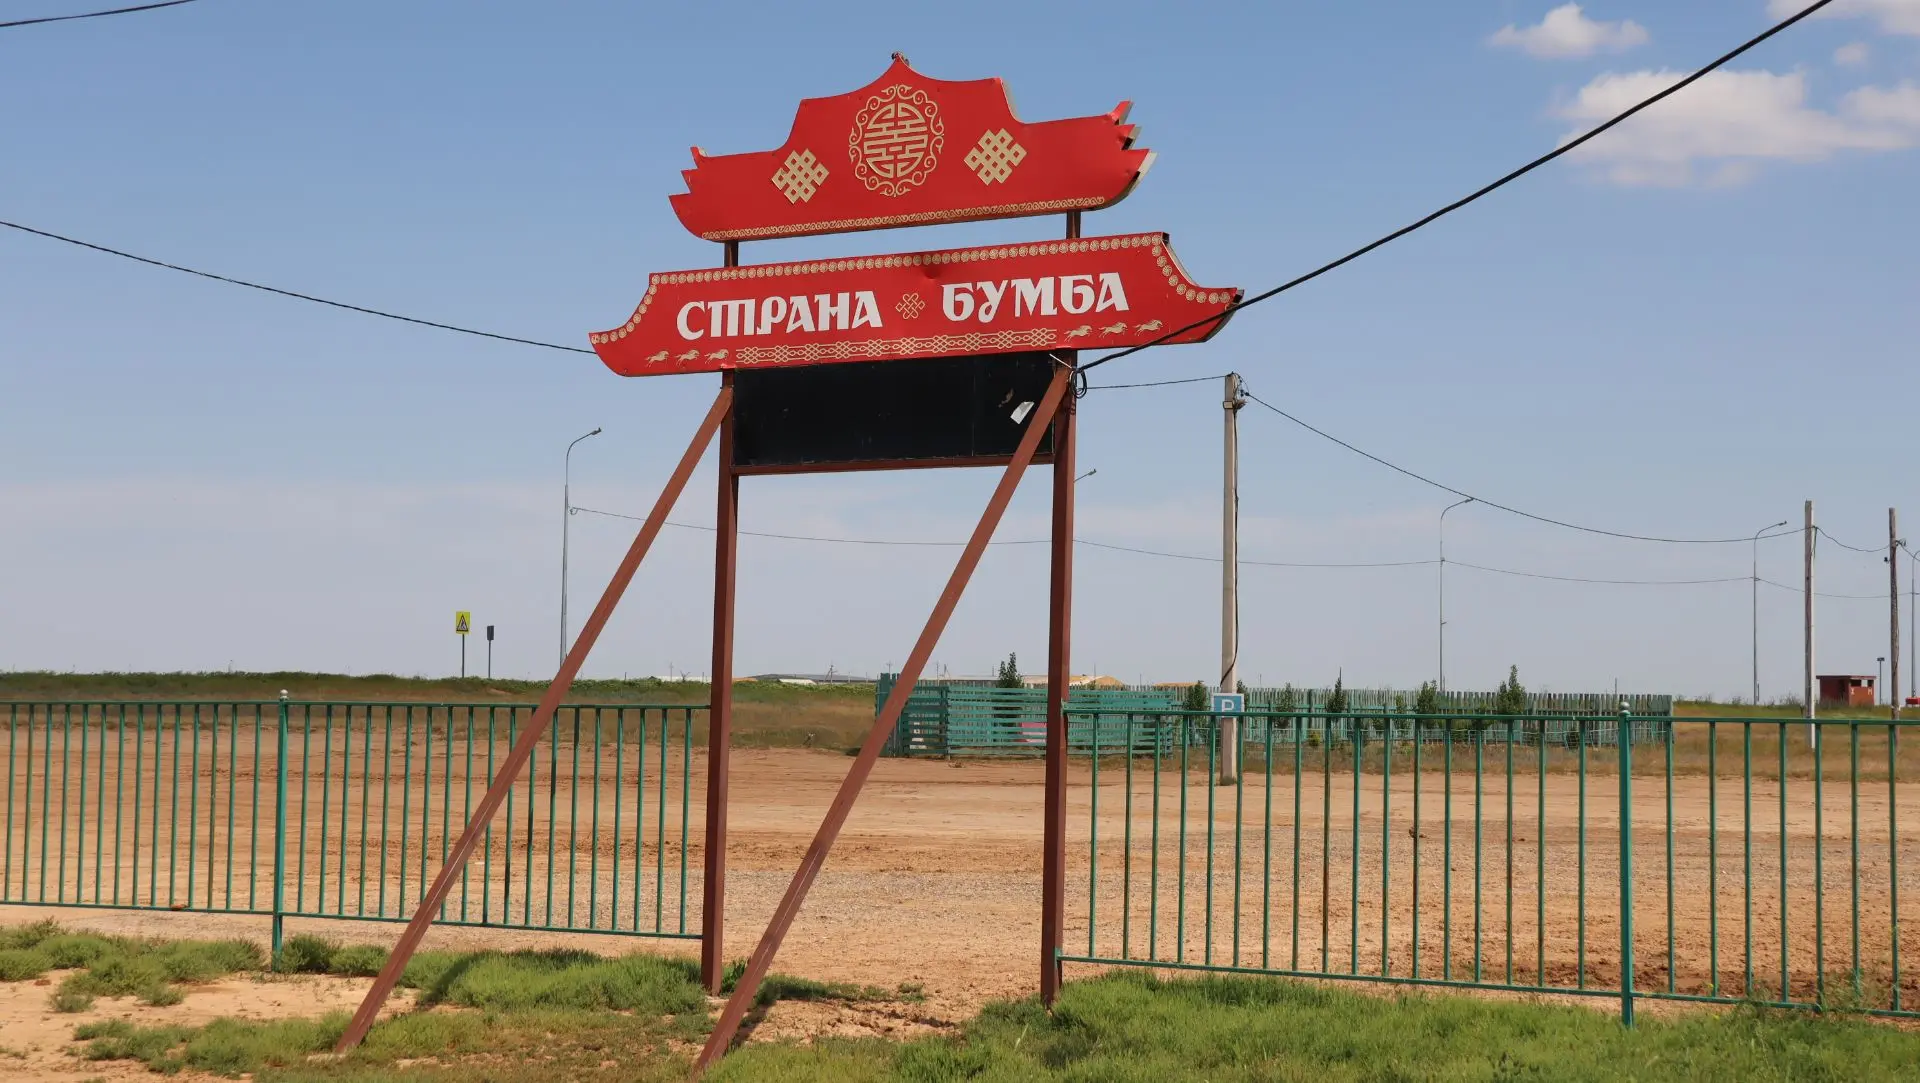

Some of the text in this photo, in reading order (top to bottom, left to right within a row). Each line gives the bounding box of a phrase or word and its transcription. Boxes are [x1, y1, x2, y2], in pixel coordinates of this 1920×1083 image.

[676, 271, 1130, 341] СТРАНА БУМБА
[1221, 699, 1235, 718] P
